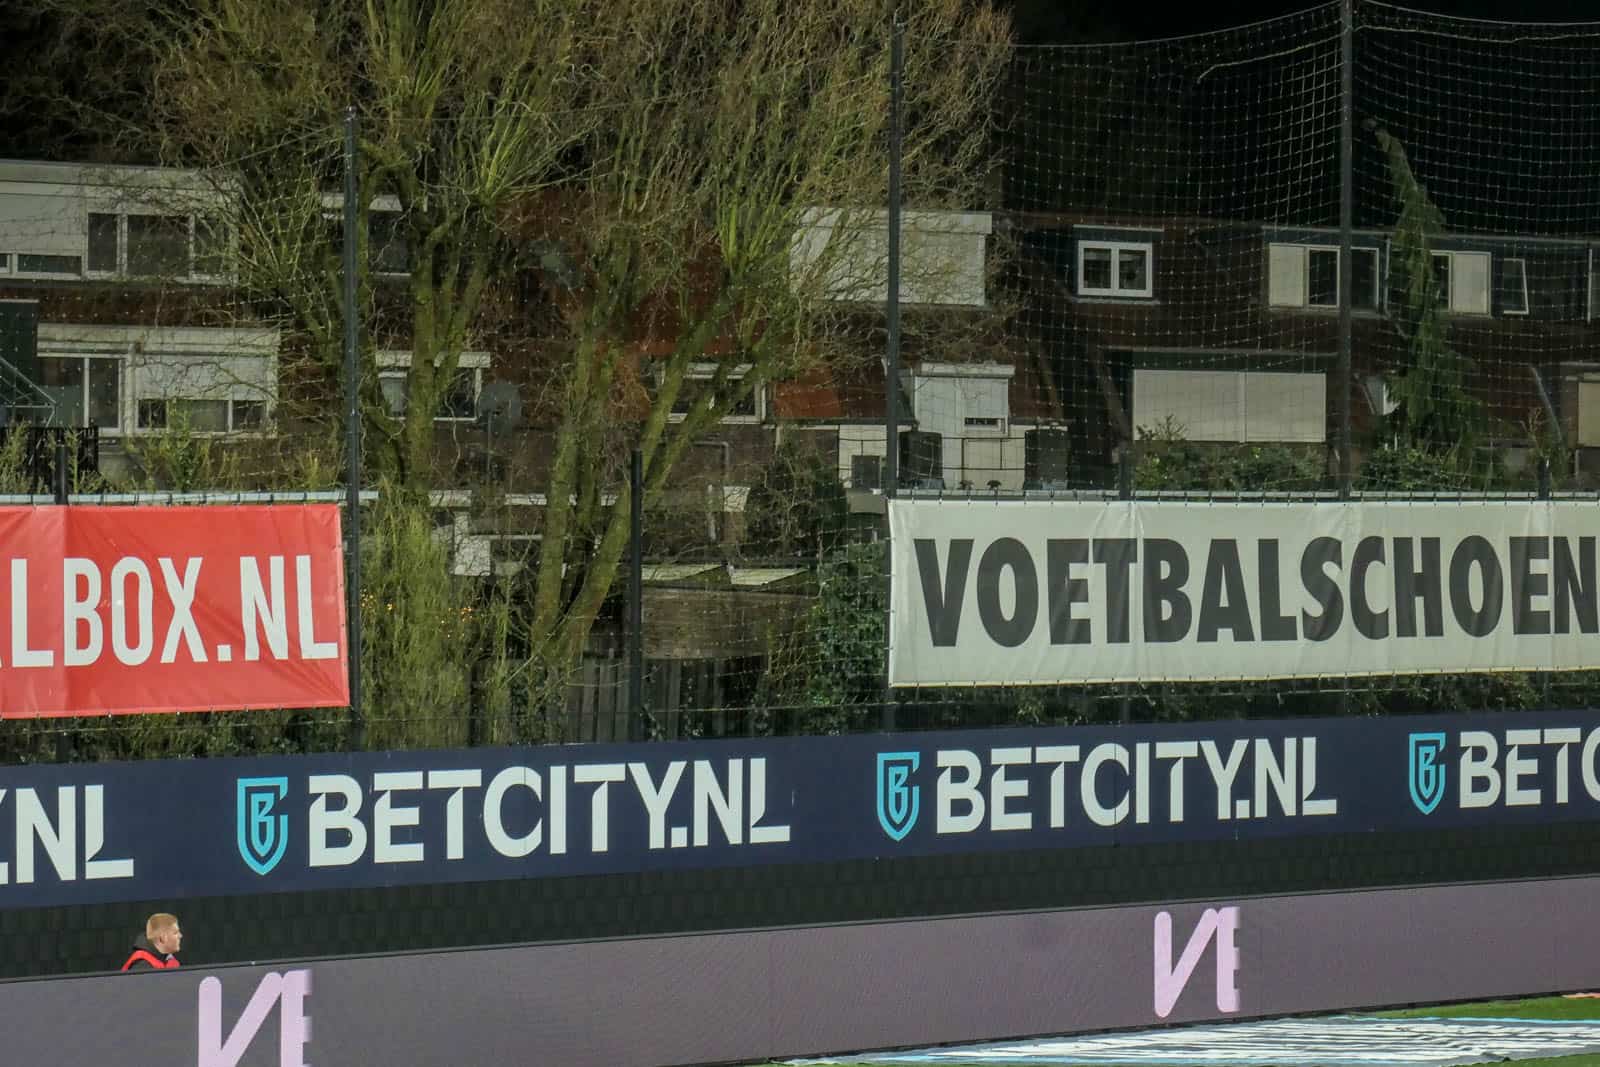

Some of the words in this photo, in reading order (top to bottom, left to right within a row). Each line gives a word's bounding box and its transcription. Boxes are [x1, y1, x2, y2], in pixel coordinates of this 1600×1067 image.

[0, 556, 338, 667] LBOX.NL
[914, 535, 1599, 648] VOETBALSCHOEN
[0, 784, 134, 884] NL
[309, 758, 790, 867] BETCITY.NL
[936, 736, 1337, 834] BETCITY.NL
